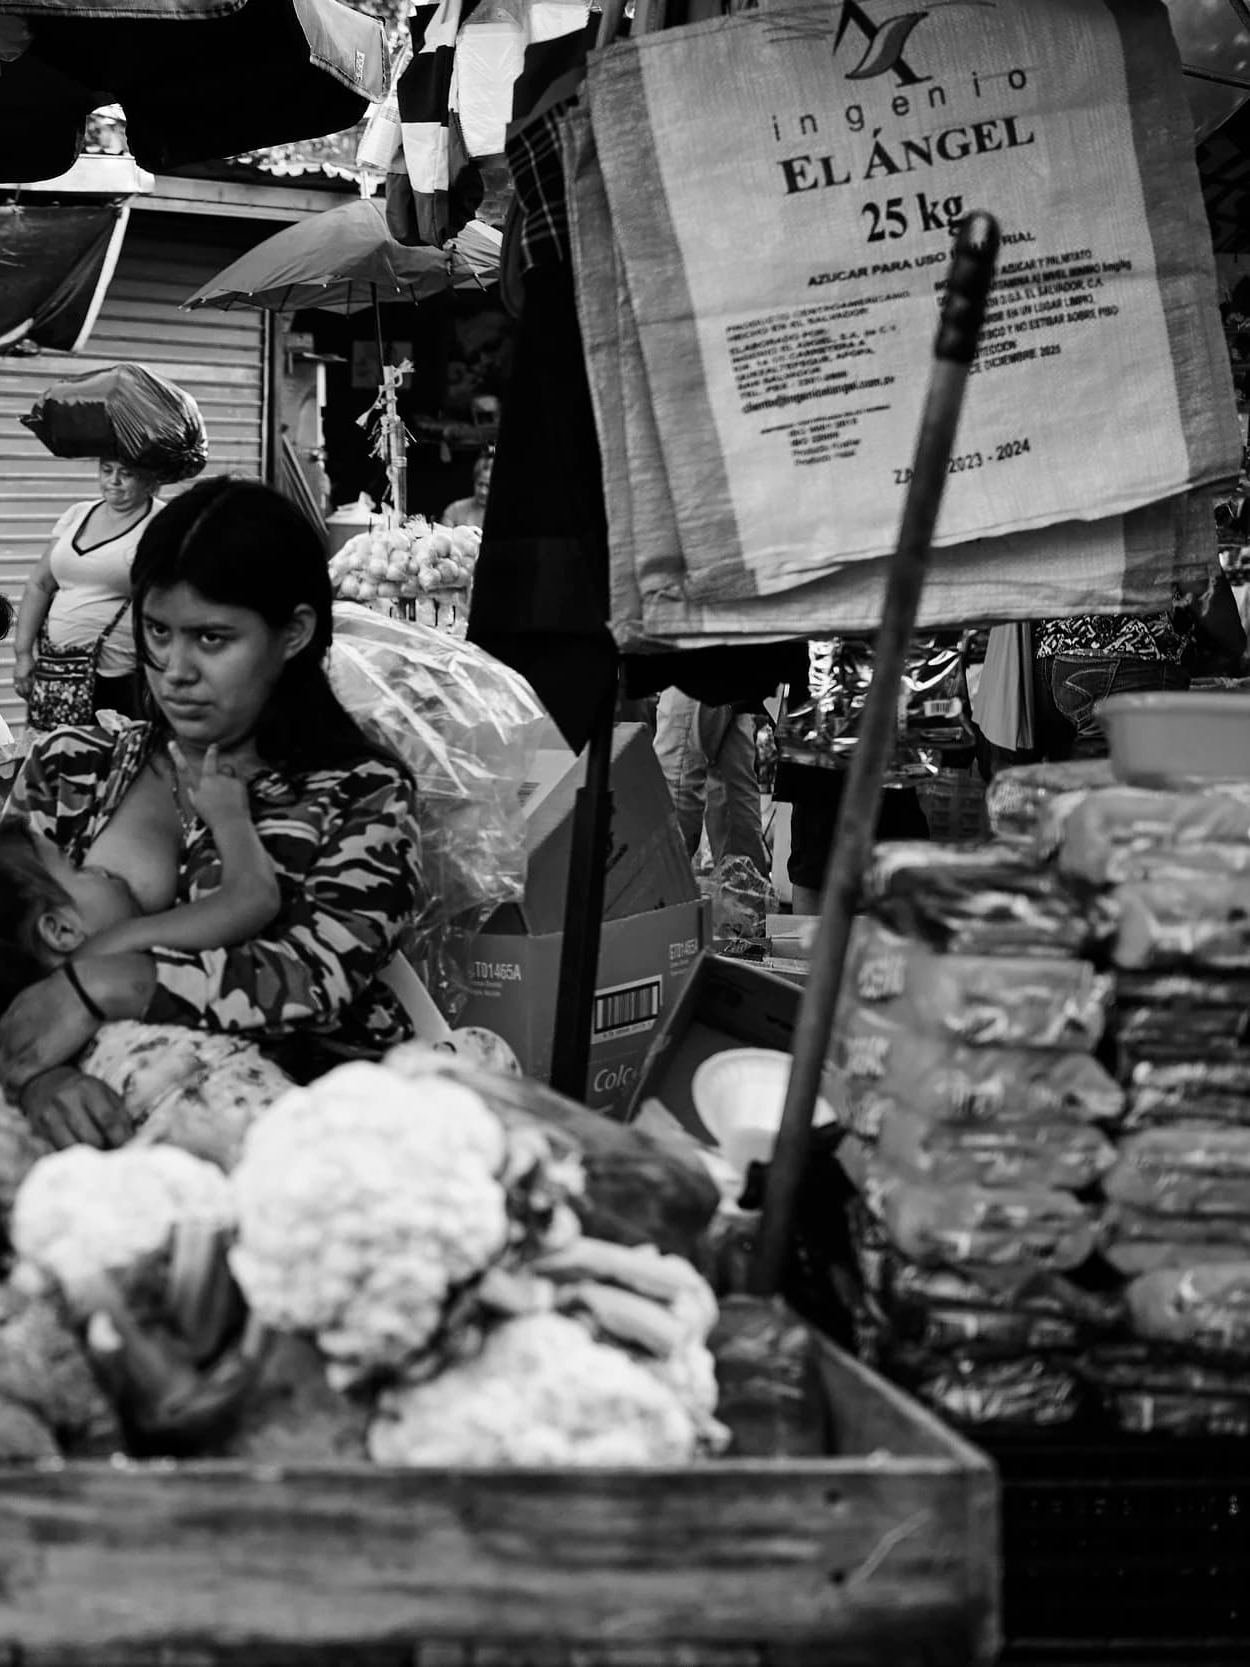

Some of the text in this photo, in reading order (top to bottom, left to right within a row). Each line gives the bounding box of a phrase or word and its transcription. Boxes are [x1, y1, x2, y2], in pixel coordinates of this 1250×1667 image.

[772, 69, 1027, 142] ingenio
[777, 114, 1036, 195] EL ÁNGEL
[861, 192, 964, 243] 25 kg
[871, 258, 913, 277] PARA
[915, 250, 947, 269] USO
[949, 451, 983, 474] 2023
[995, 437, 1032, 462] 2024
